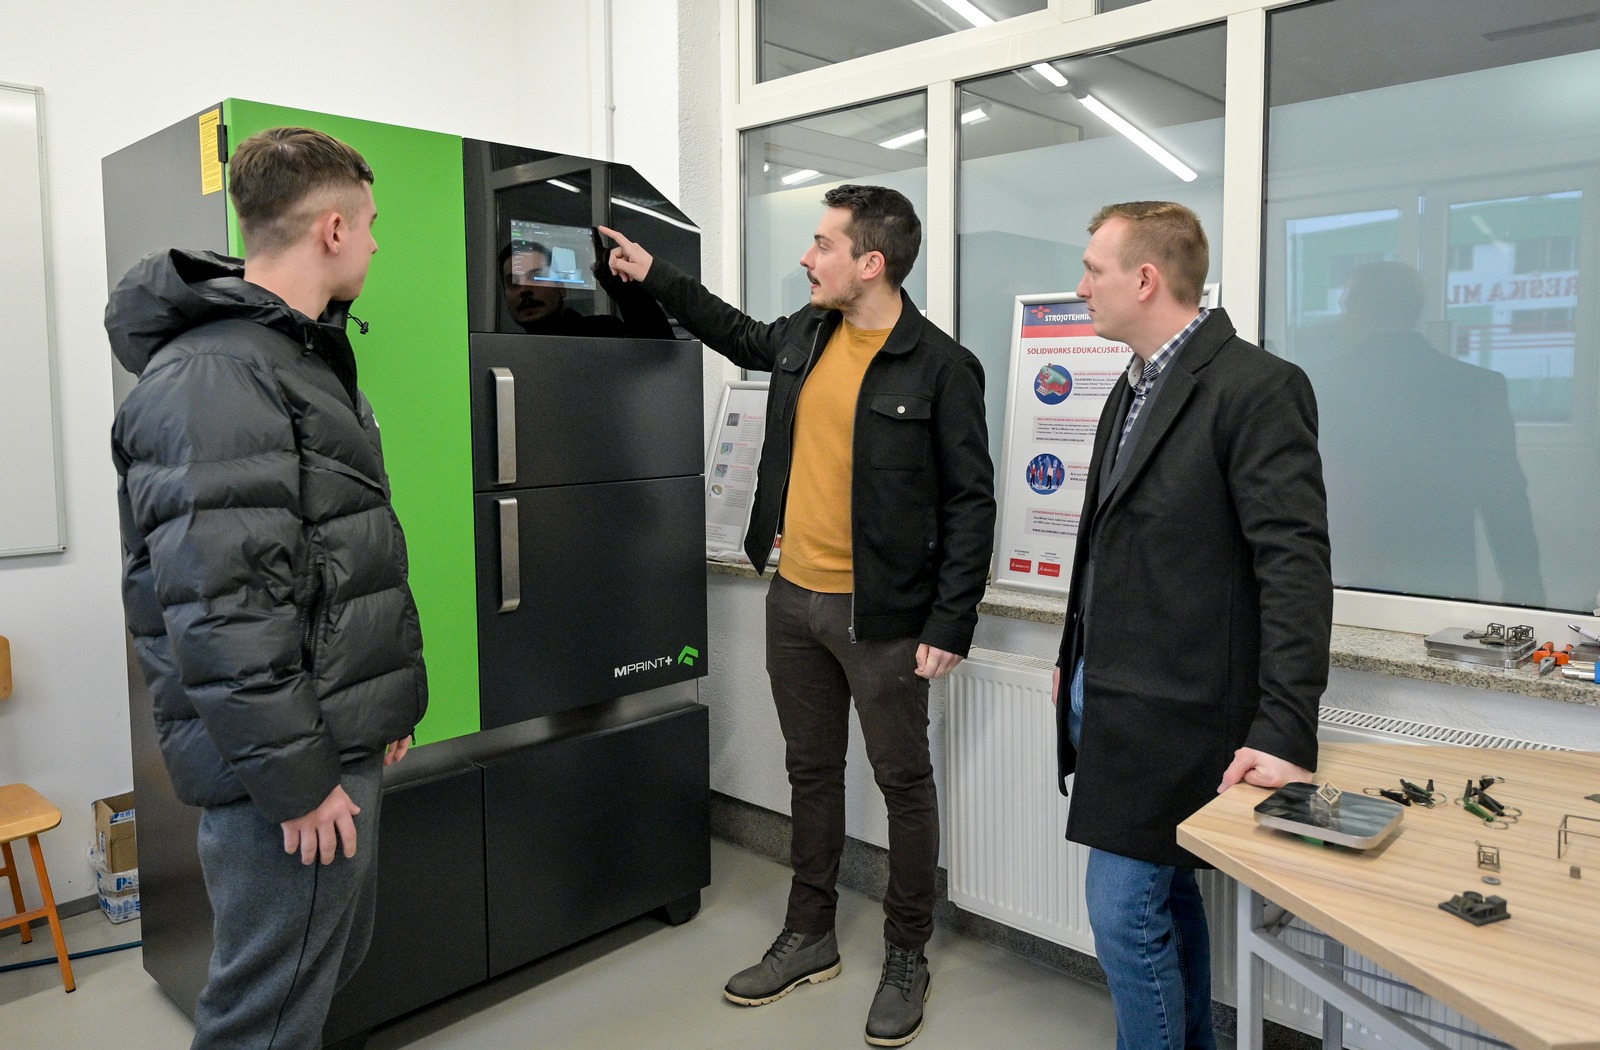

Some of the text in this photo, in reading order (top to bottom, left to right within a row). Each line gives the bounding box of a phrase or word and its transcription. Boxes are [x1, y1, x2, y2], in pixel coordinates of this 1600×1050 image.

[1027, 347, 1071, 355] SOLIDWORKS
[1072, 346, 1120, 354] EDUKACIJSKE
[614, 656, 672, 678] MPRINT+
